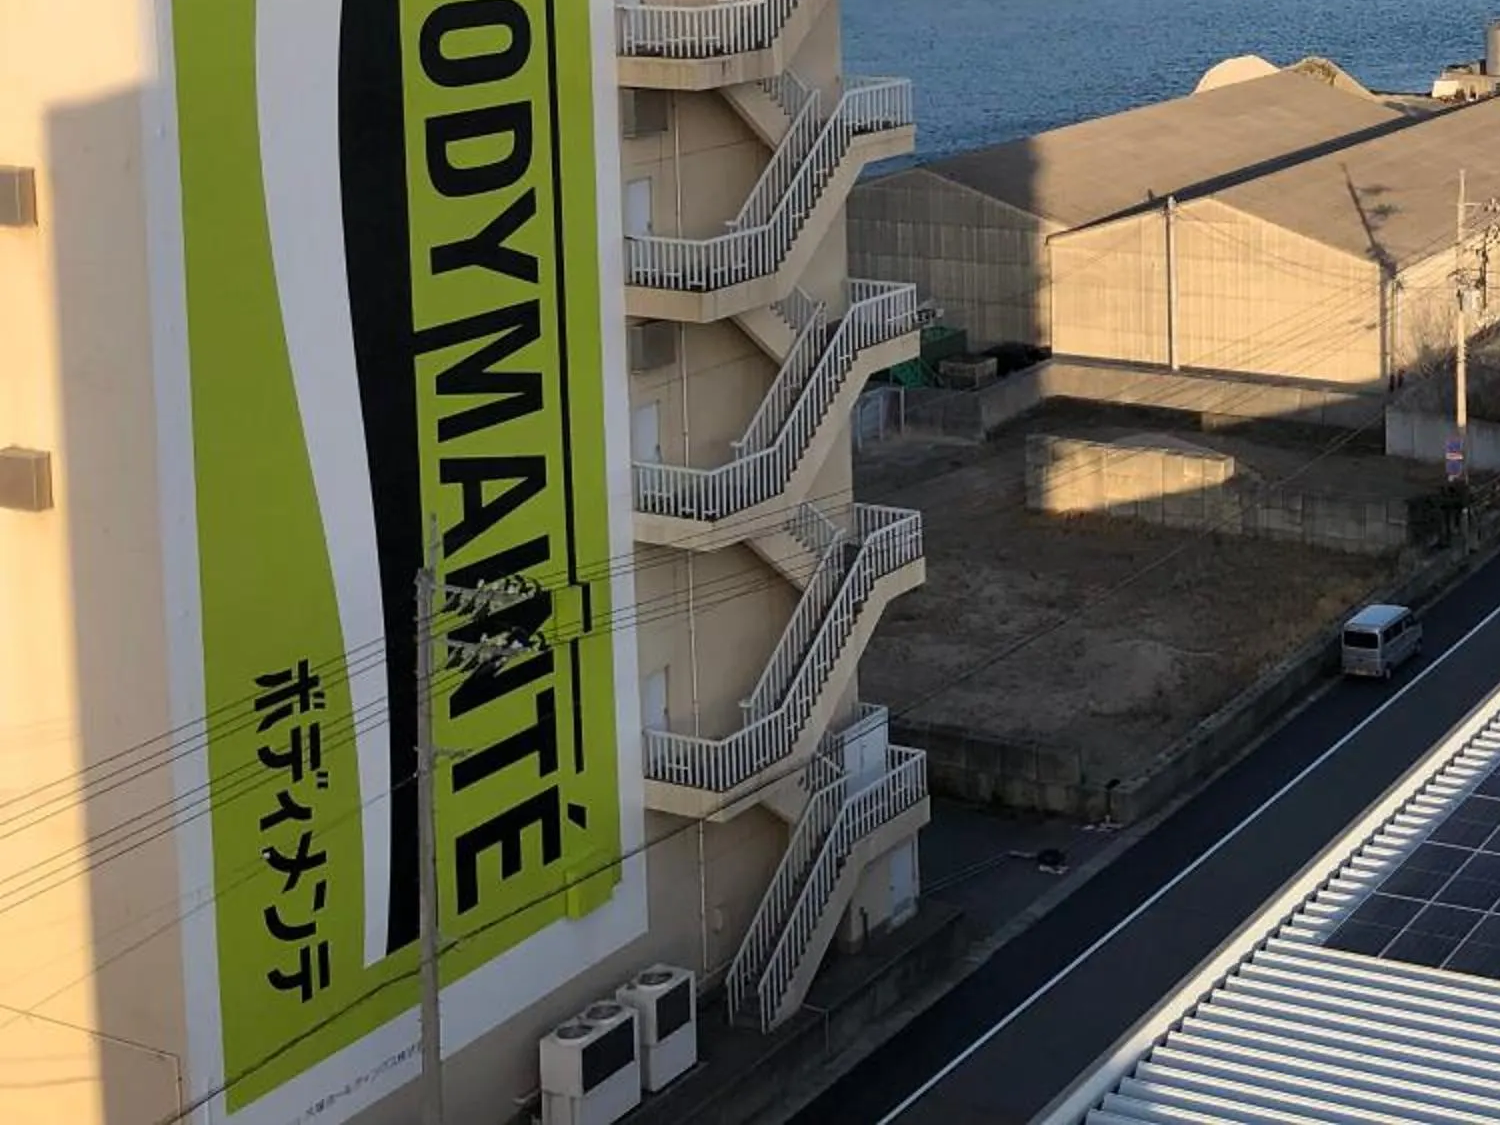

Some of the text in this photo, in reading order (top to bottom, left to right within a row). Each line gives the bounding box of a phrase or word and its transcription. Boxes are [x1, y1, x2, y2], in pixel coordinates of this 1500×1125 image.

[253, 659, 331, 1003] ボディメンテ
